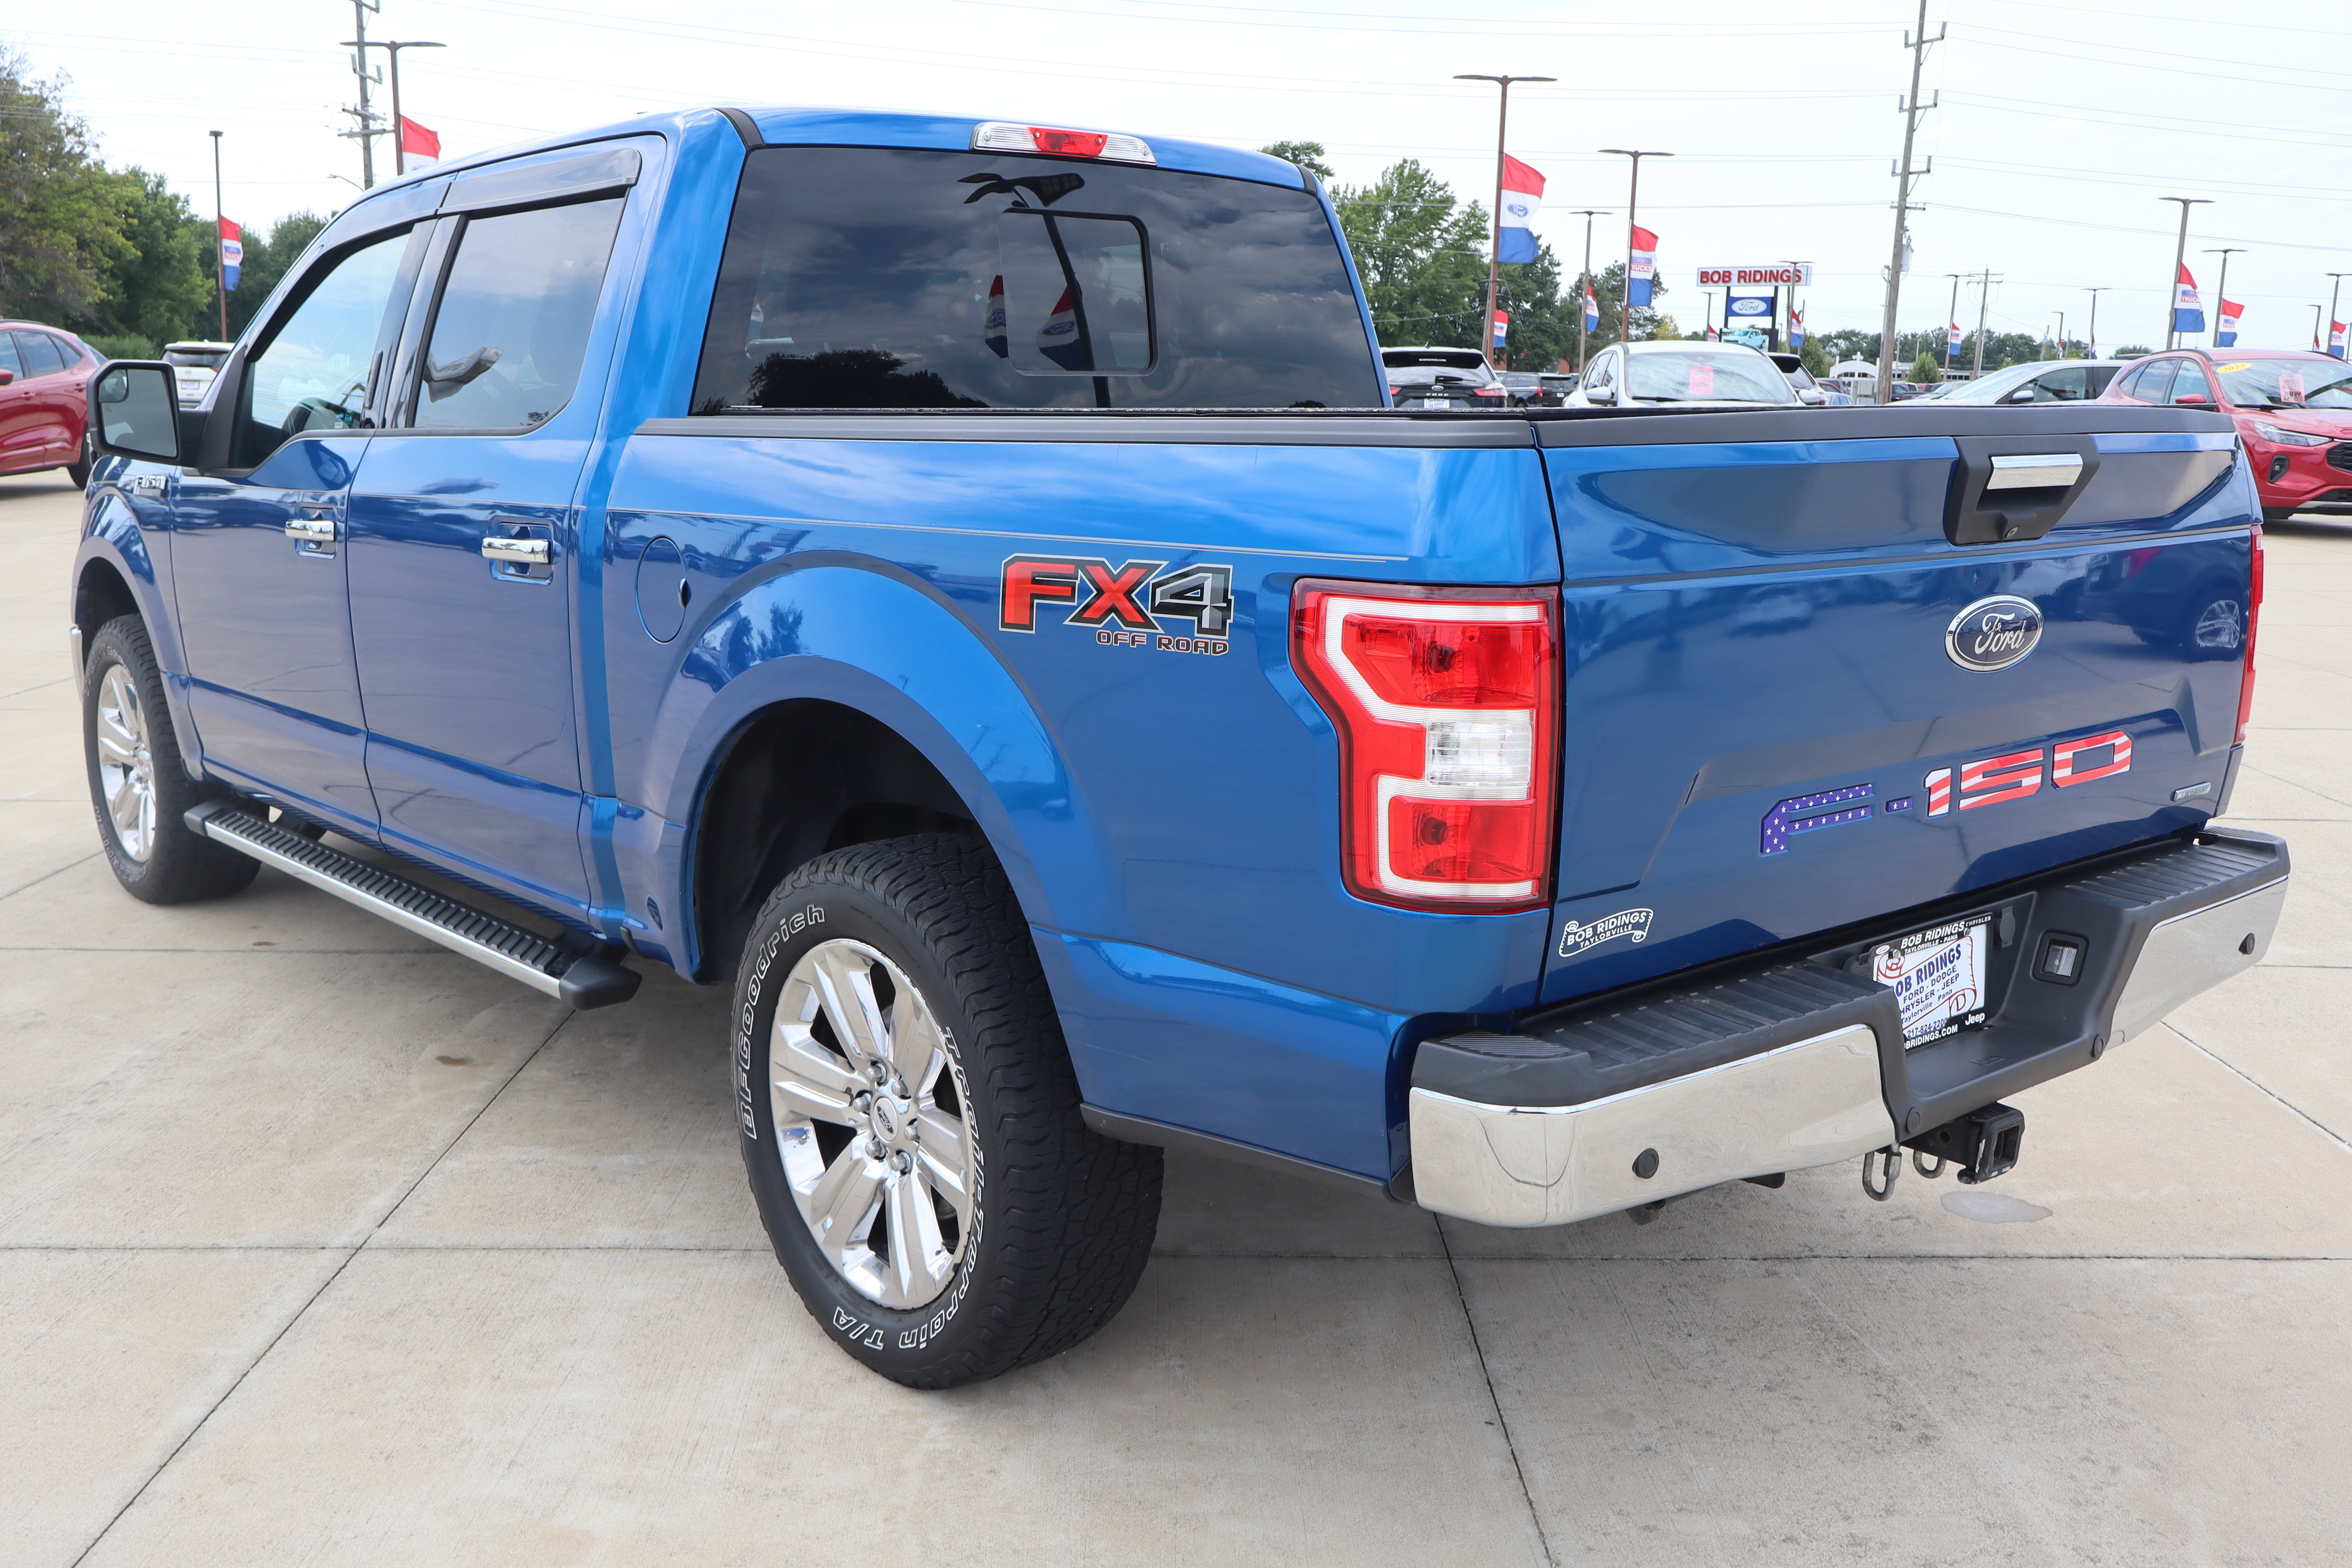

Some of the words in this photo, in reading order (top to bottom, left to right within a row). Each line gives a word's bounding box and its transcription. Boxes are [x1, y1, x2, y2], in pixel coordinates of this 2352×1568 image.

[1631, 264, 1652, 272] RUCKS
[1700, 270, 1732, 283] BOB
[1737, 269, 1802, 283] RIDINGS
[1738, 301, 1760, 312] Ford
[999, 552, 1234, 639] FX4
[1096, 630, 1147, 648] OFF
[1156, 635, 1229, 656] ROAD
[1975, 612, 2027, 654] Ford
[1760, 731, 2132, 858] F-150
[1567, 927, 1593, 946] BOB
[1597, 912, 1646, 934] RIDINGS
[1580, 924, 1633, 948] TAYLORVILLE
[1900, 933, 1922, 949] BOB
[1924, 921, 1964, 942] RIDINGS
[1966, 916, 1991, 927] CHRYSLER
[1904, 940, 1939, 955] TAYLORVILLE
[1944, 934, 1958, 943] PANA
[1890, 975, 1912, 997] OB
[1916, 944, 1961, 985] RIDINGS
[1903, 986, 1924, 1004] FORD
[1931, 965, 1957, 987] DODGE
[1900, 990, 1935, 1016] HRYSLER
[1942, 973, 1960, 992] JEEP
[1901, 1001, 1933, 1024] Taylorville
[1938, 989, 1953, 1002] Pana
[738, 904, 826, 1140] BFGoodrich
[1965, 1012, 1985, 1026] Jeep
[833, 1307, 884, 1350] T/A
